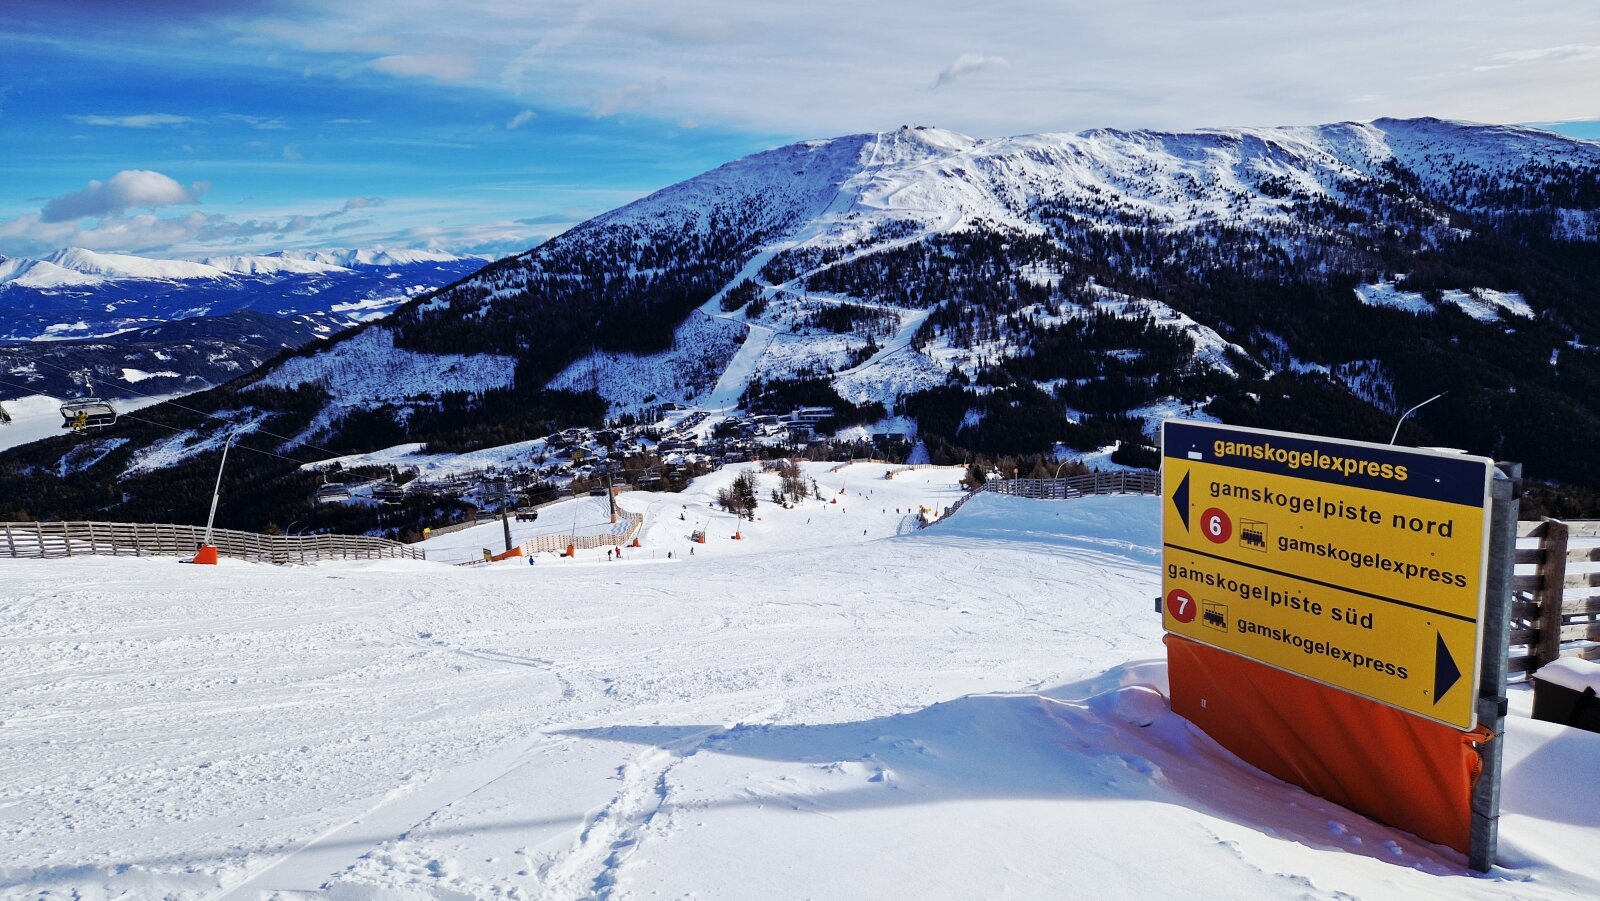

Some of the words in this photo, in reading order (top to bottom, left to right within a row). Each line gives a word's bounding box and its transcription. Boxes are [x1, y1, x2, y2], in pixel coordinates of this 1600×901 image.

[1213, 438, 1408, 481] gamskogelexpress
[1210, 480, 1382, 525] gamskogelpiste
[1392, 514, 1453, 538] nord
[1209, 516, 1222, 536] 6
[1278, 535, 1467, 588] gamskogelexpress
[1168, 563, 1322, 615] gamskogelpiste
[1331, 607, 1373, 630] süd
[1176, 597, 1189, 615] 7
[1237, 617, 1408, 680] gamskogelexpress
